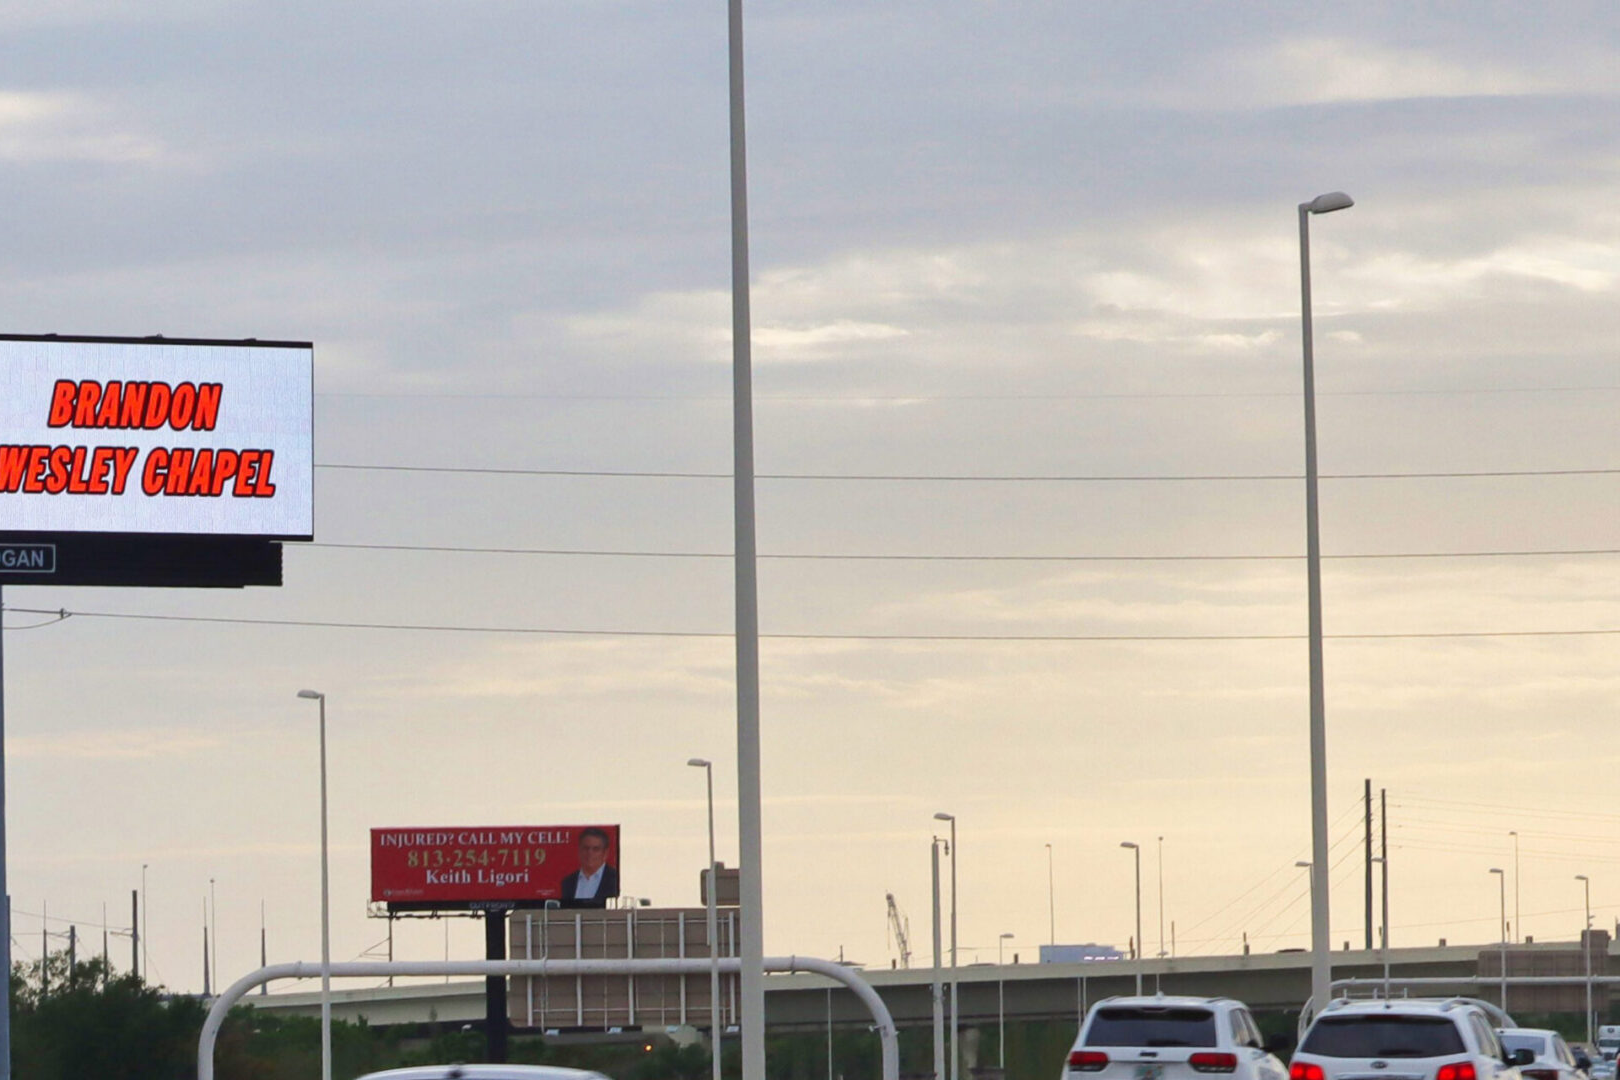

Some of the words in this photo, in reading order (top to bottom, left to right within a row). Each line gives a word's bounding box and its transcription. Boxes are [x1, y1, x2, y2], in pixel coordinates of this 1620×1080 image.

[48, 380, 222, 430] BRANDON
[142, 447, 275, 497] CHAPEL
[380, 832, 454, 847] INJURED?
[458, 832, 495, 846] CALL
[500, 832, 523, 845] MY
[527, 831, 570, 845] CELL!
[426, 870, 471, 885] Keith
[477, 869, 529, 886] Ligori
